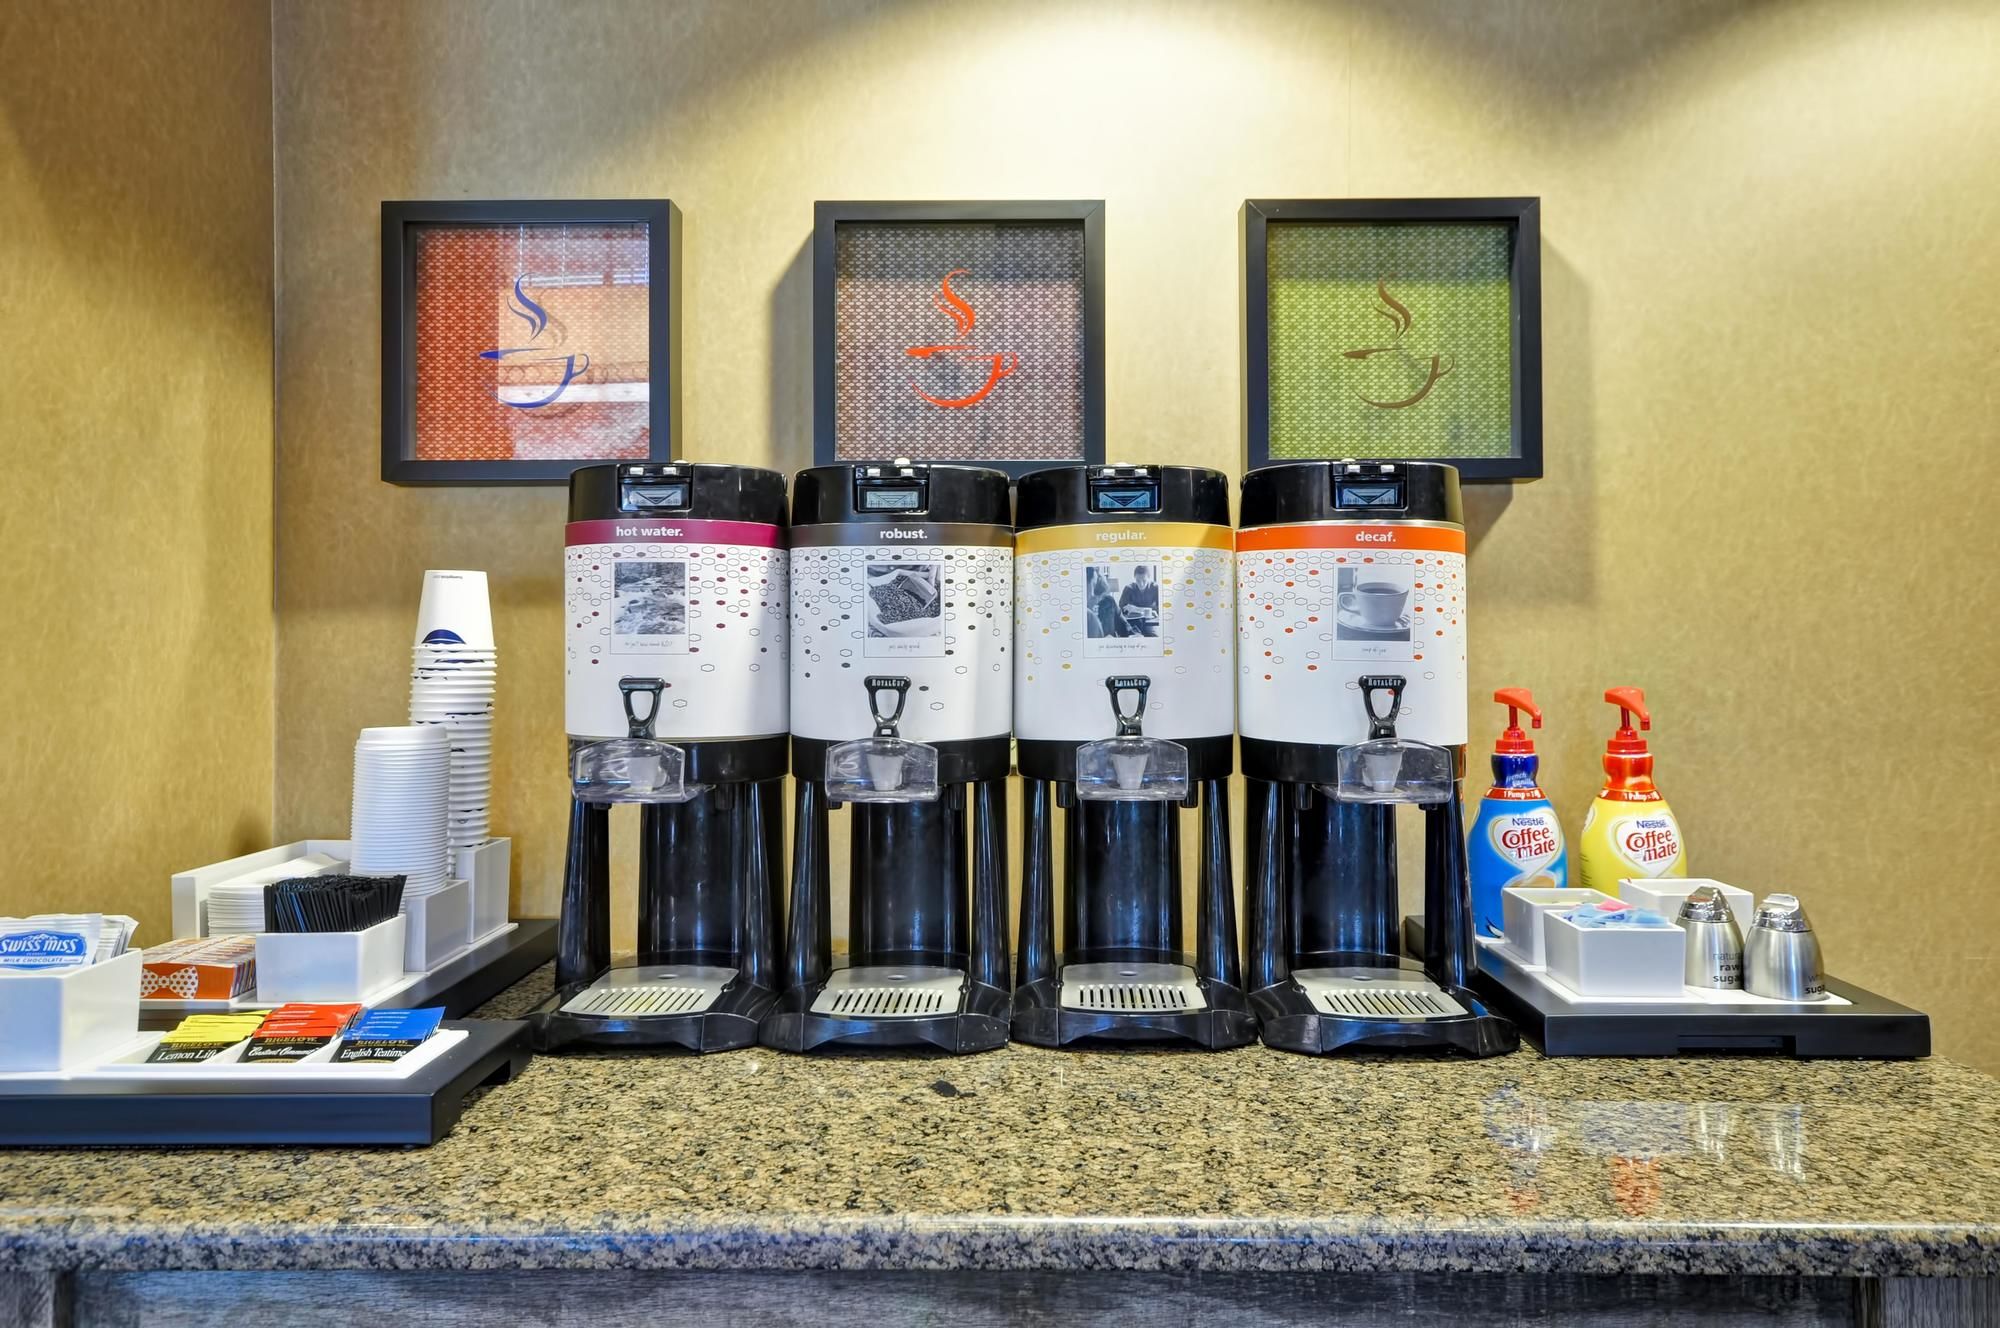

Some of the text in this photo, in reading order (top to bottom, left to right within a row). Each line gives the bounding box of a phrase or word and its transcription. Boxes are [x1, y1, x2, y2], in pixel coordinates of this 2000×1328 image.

[615, 526, 684, 537] hot water.
[880, 528, 928, 539] robust.
[1095, 530, 1148, 544] regular.
[1355, 531, 1397, 542] decaf.
[1516, 839, 1556, 859] mate
[1642, 842, 1678, 861] mate
[156, 1051, 195, 1061] Lemon
[340, 1047, 407, 1060] English Teatime
